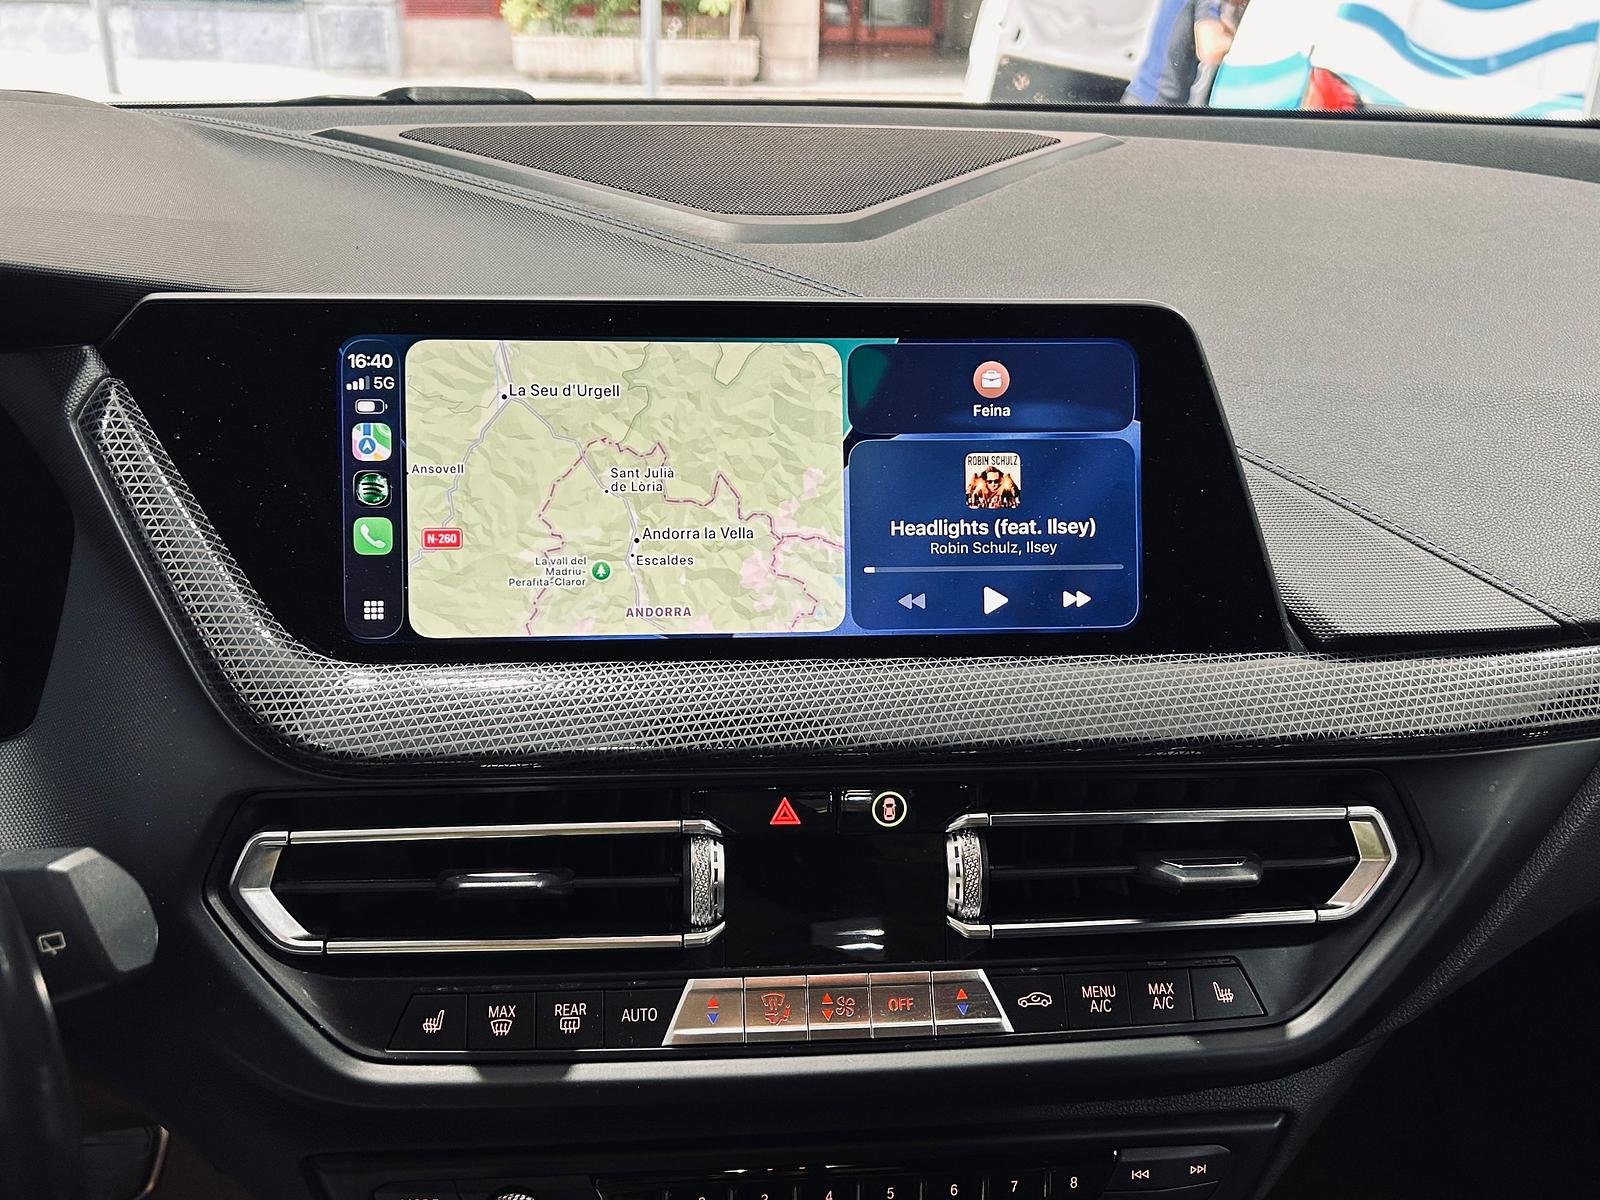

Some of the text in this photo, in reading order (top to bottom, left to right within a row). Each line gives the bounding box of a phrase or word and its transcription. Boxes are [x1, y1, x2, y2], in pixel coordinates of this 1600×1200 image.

[347, 353, 394, 369] 16:40
[373, 377, 395, 389] 5G
[509, 383, 621, 399] La Seu d'Urgell
[973, 403, 1011, 417] Feina
[411, 464, 465, 475] Ansovell
[610, 467, 674, 479] Sant Julià
[610, 480, 663, 492] de Lòria
[642, 526, 754, 540] Andorra la Vella
[890, 517, 1096, 539] Headlights (feat. Ilsey)
[427, 533, 457, 545] N-260
[930, 541, 1058, 556] Robin Schulz, Ilsey
[535, 556, 587, 566] La vall del
[636, 555, 694, 566] Escaldes
[545, 567, 587, 576] Madriu-
[508, 577, 587, 587] Perafita-Claror
[625, 606, 692, 618] ANDORRA
[1081, 985, 1116, 998] MENU
[1148, 982, 1175, 995] MAX
[554, 1002, 587, 1017] REAR
[888, 997, 914, 1012] OFF
[1090, 999, 1112, 1013] A/C
[1152, 996, 1175, 1010] A/C
[488, 1005, 516, 1018] MAX
[621, 1007, 658, 1022] AUTO
[1010, 1180, 1018, 1193] 7
[1069, 1176, 1078, 1189] 8
[825, 1190, 833, 1200] 4
[886, 1187, 894, 1200] 5
[950, 1184, 958, 1196] 6
